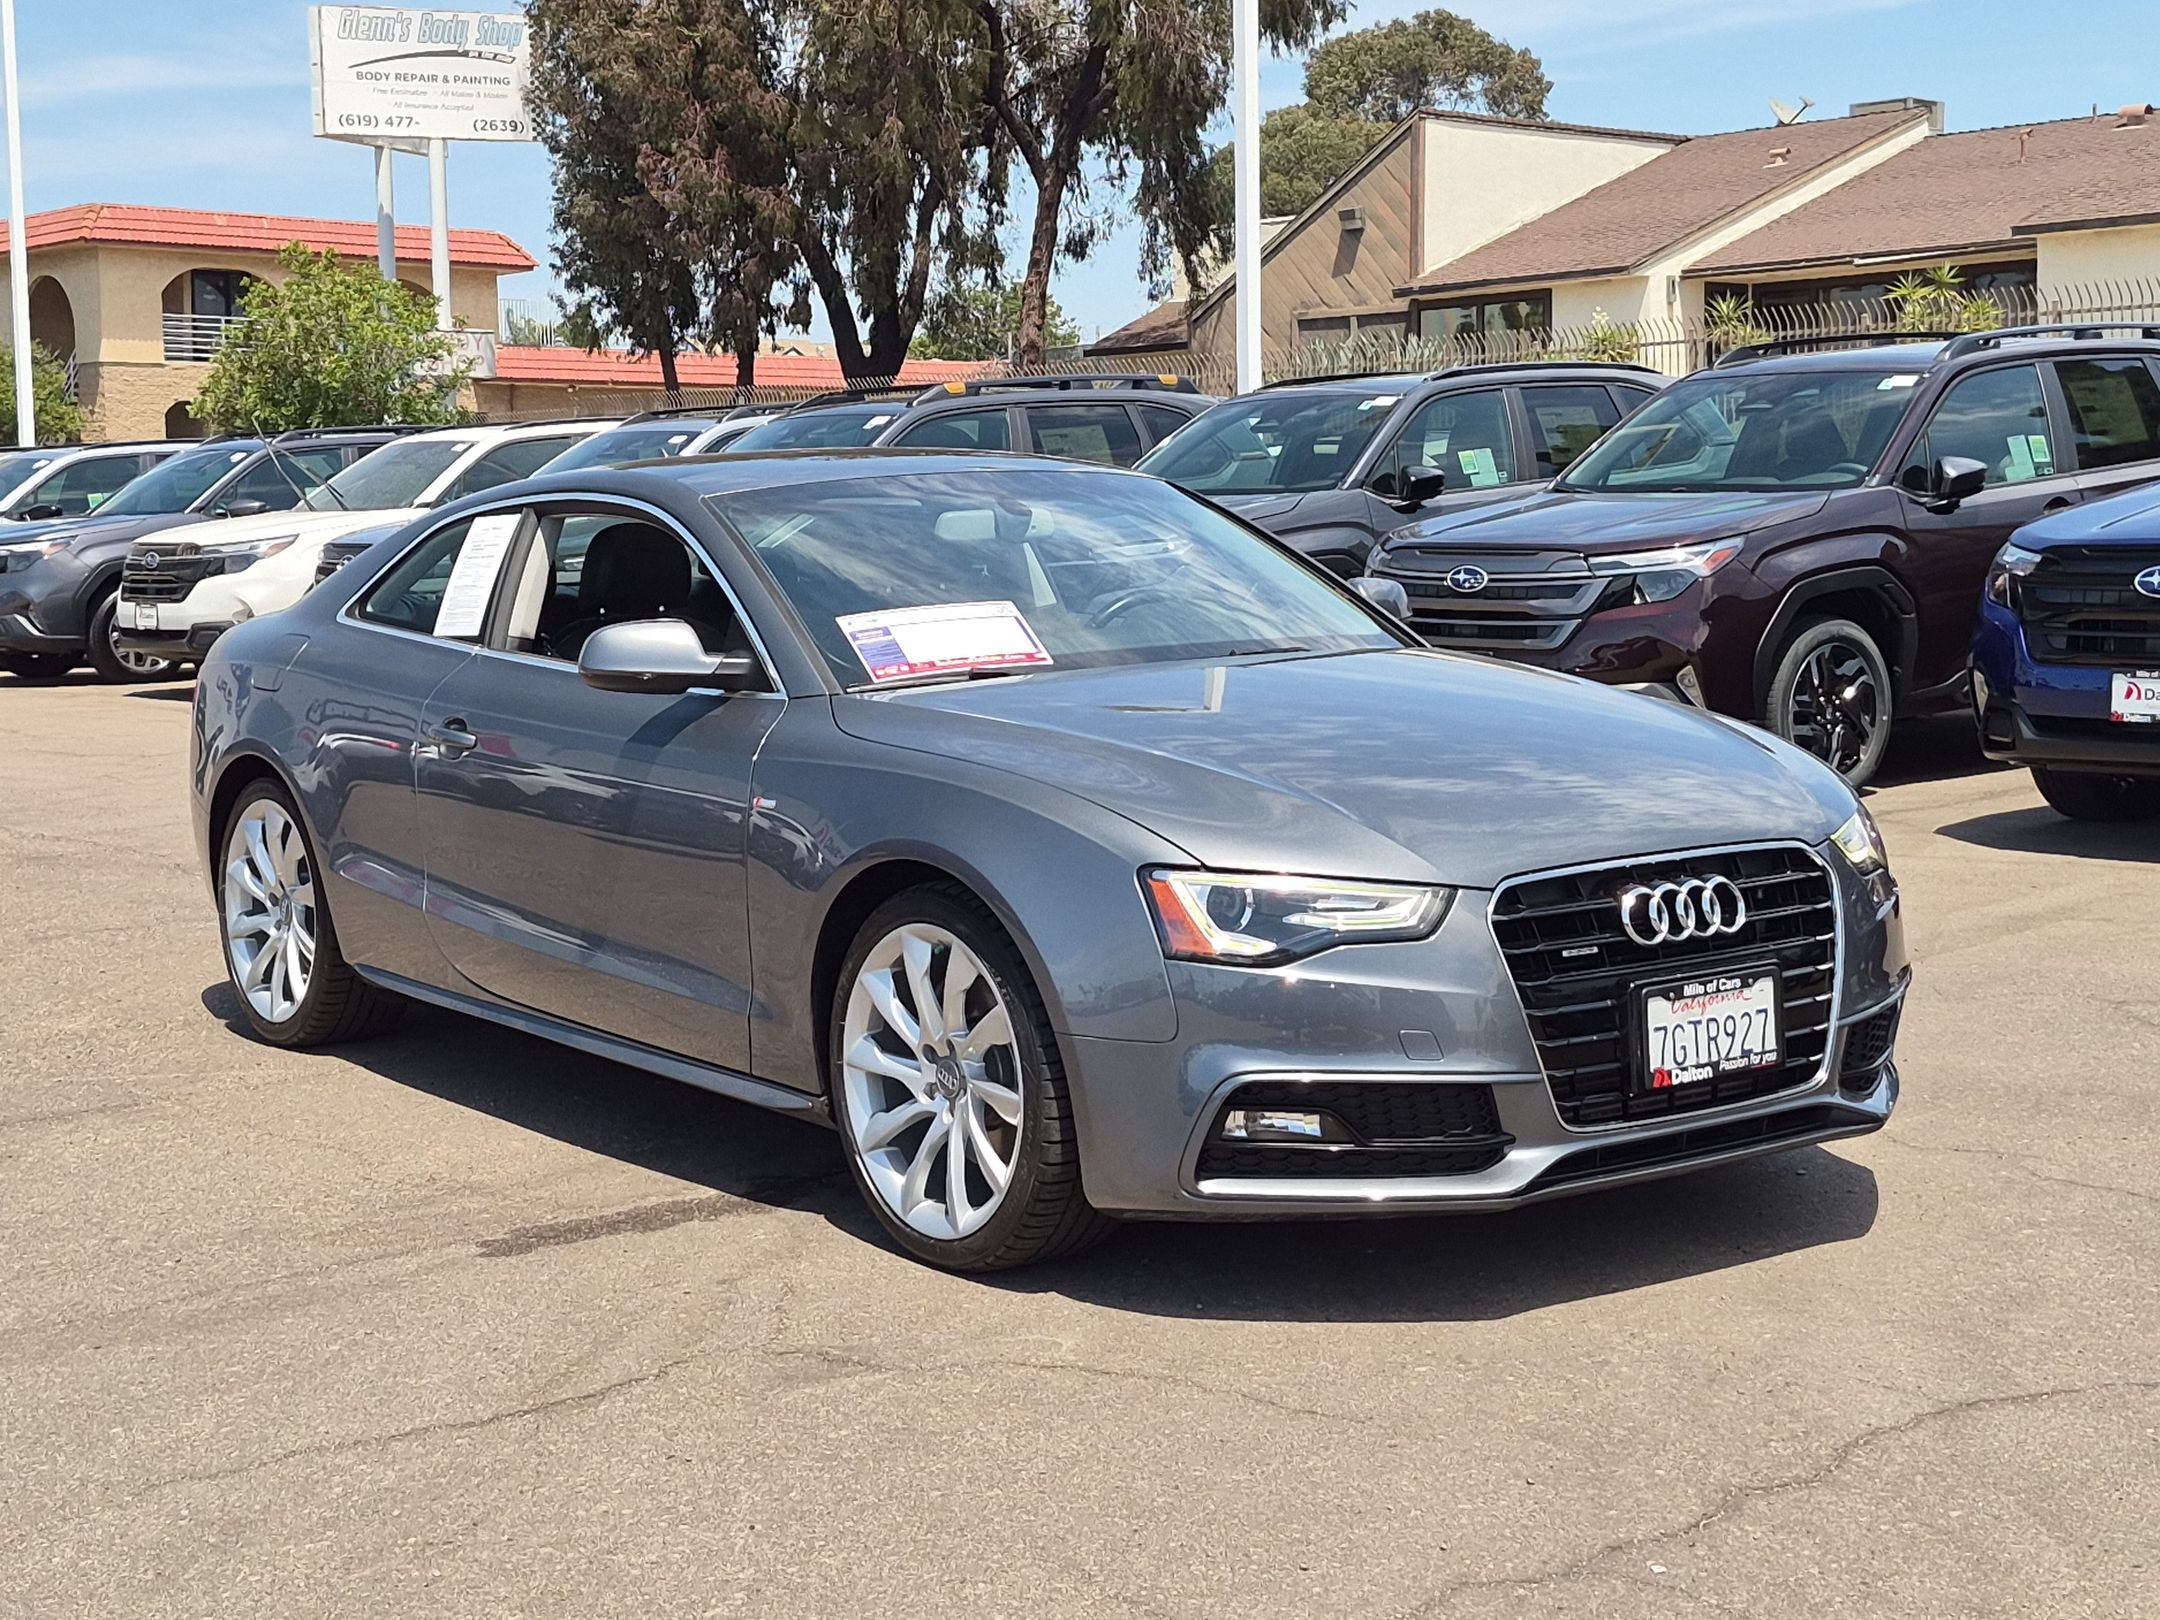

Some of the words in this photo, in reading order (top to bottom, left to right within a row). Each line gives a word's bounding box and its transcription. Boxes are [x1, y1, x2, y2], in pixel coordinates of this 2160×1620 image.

[337, 8, 412, 42] Glenn's
[417, 12, 469, 52] Body
[475, 15, 524, 51] Shop
[356, 71, 391, 81] BODY
[395, 72, 438, 83] REPAIR
[442, 74, 450, 83] &
[453, 76, 511, 86] PAINTING
[338, 113, 379, 129] (619)
[385, 115, 420, 128] 477-
[473, 119, 525, 134] (2639)
[1683, 983, 1705, 997] Mile
[1706, 980, 1718, 993] of
[1719, 977, 1741, 990] Cars
[1671, 990, 1752, 1016] California
[1653, 1008, 1768, 1067] 7GTR927
[1719, 1057, 1749, 1071] Passion
[1750, 1053, 1761, 1065] for
[1761, 1051, 1777, 1065] you
[1671, 1065, 1713, 1086] Dalton
